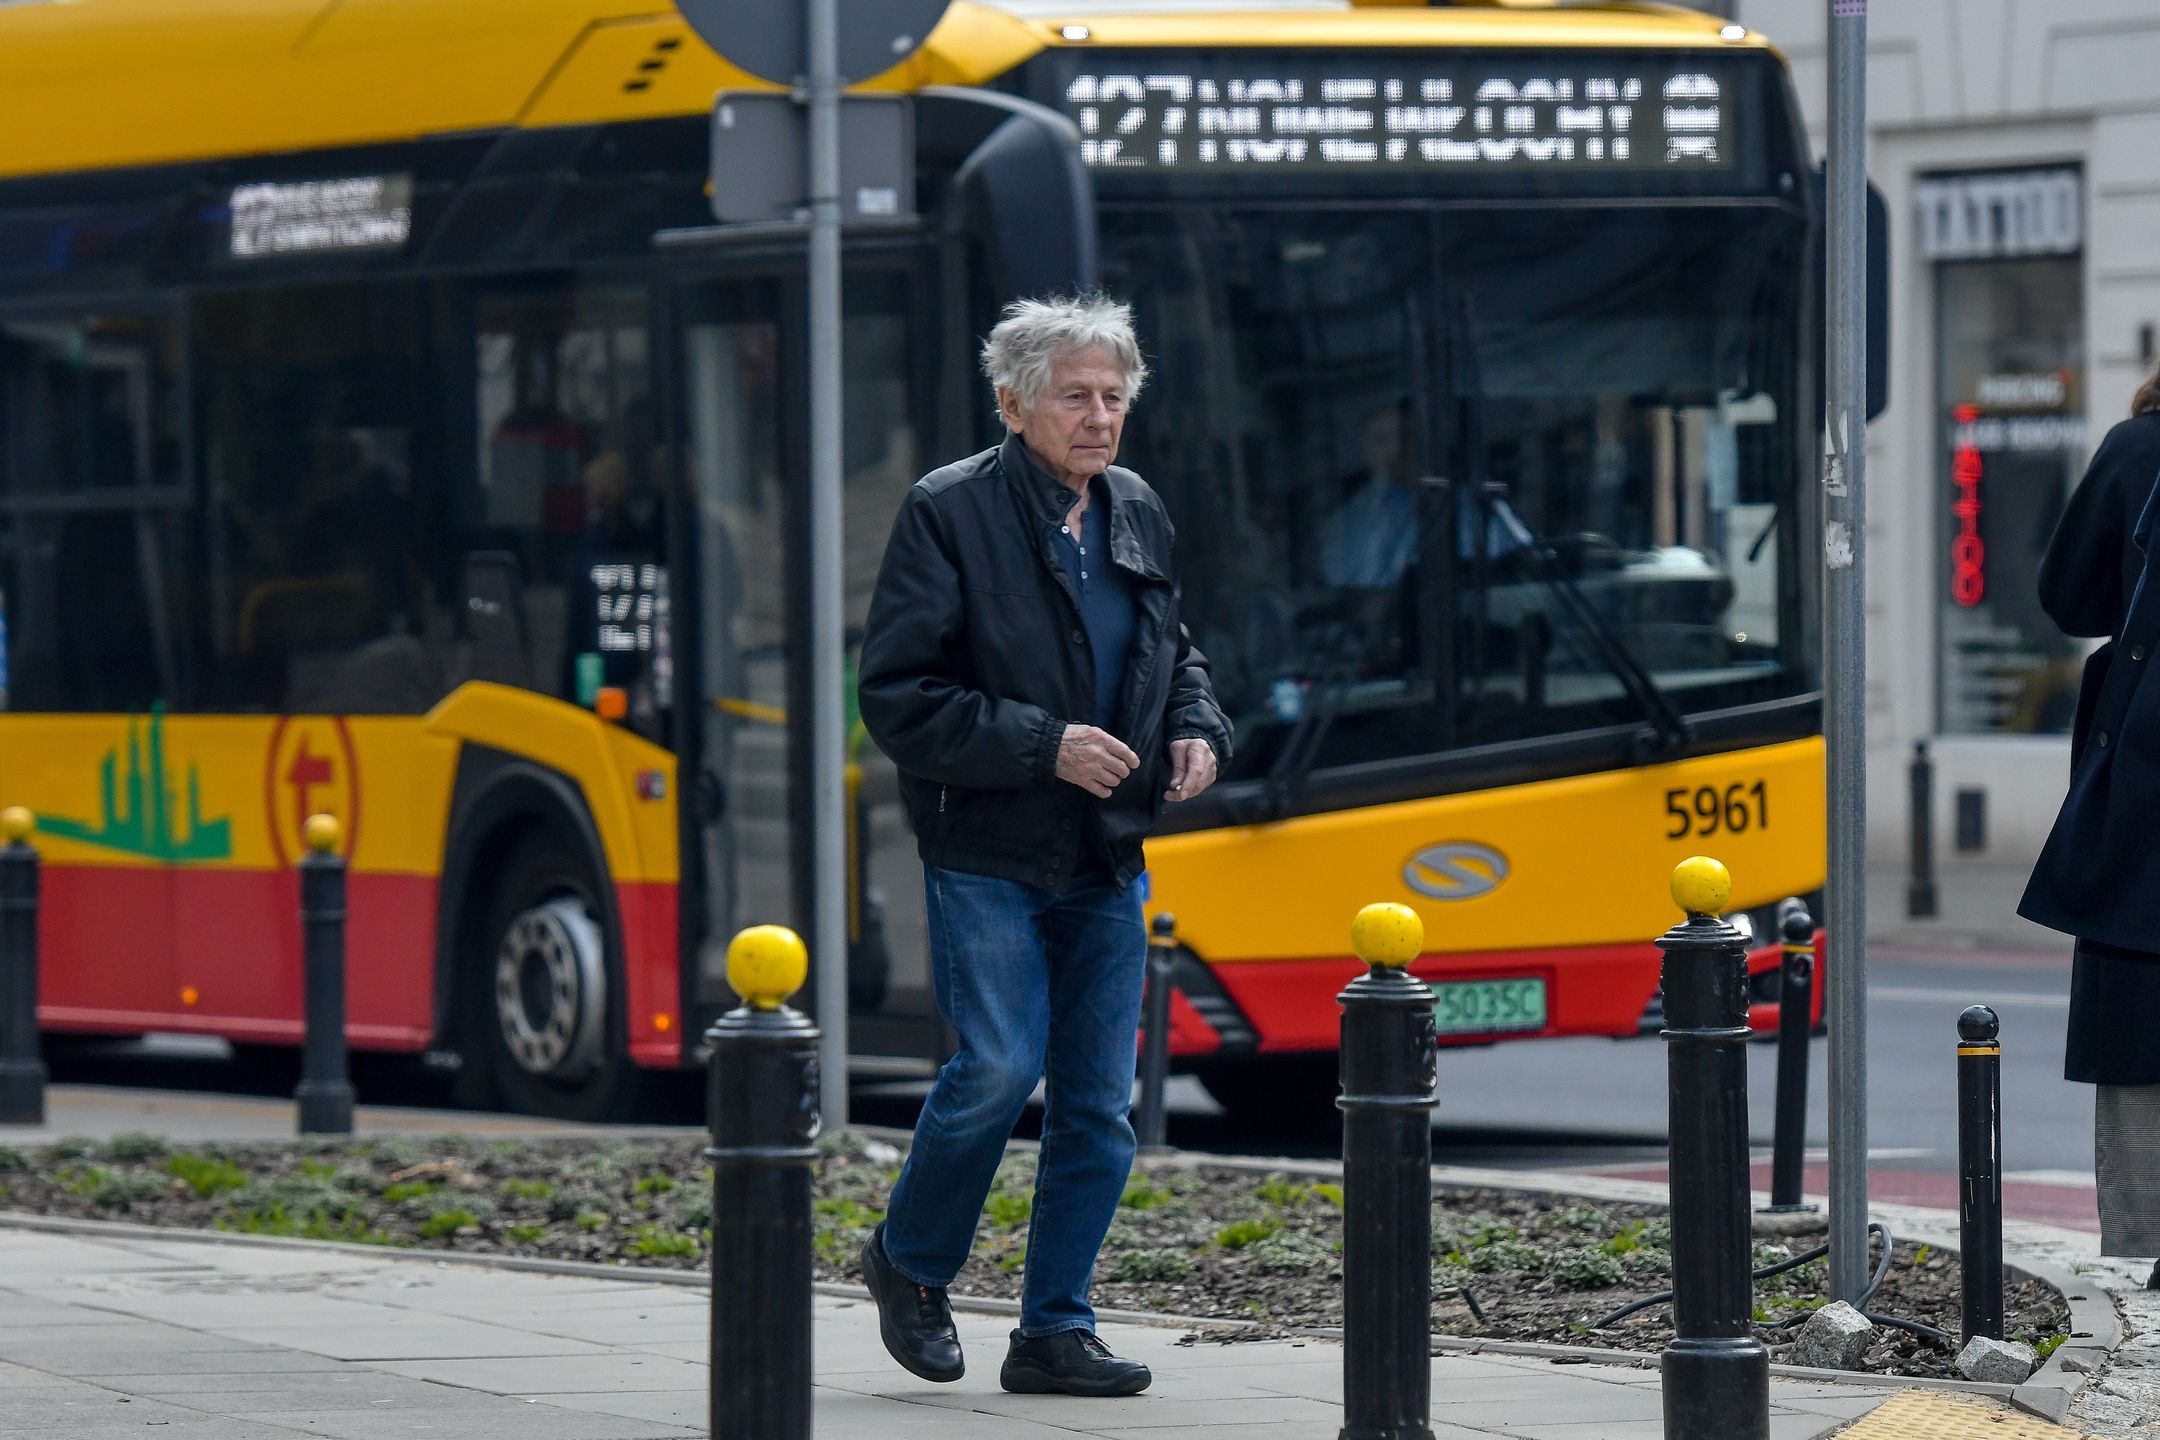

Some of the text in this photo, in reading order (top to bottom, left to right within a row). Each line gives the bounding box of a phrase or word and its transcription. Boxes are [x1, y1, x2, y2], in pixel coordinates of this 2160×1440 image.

[1066, 74, 1193, 167] 127
[1197, 78, 1377, 163] NOWE
[1665, 779, 1768, 841] 5961
